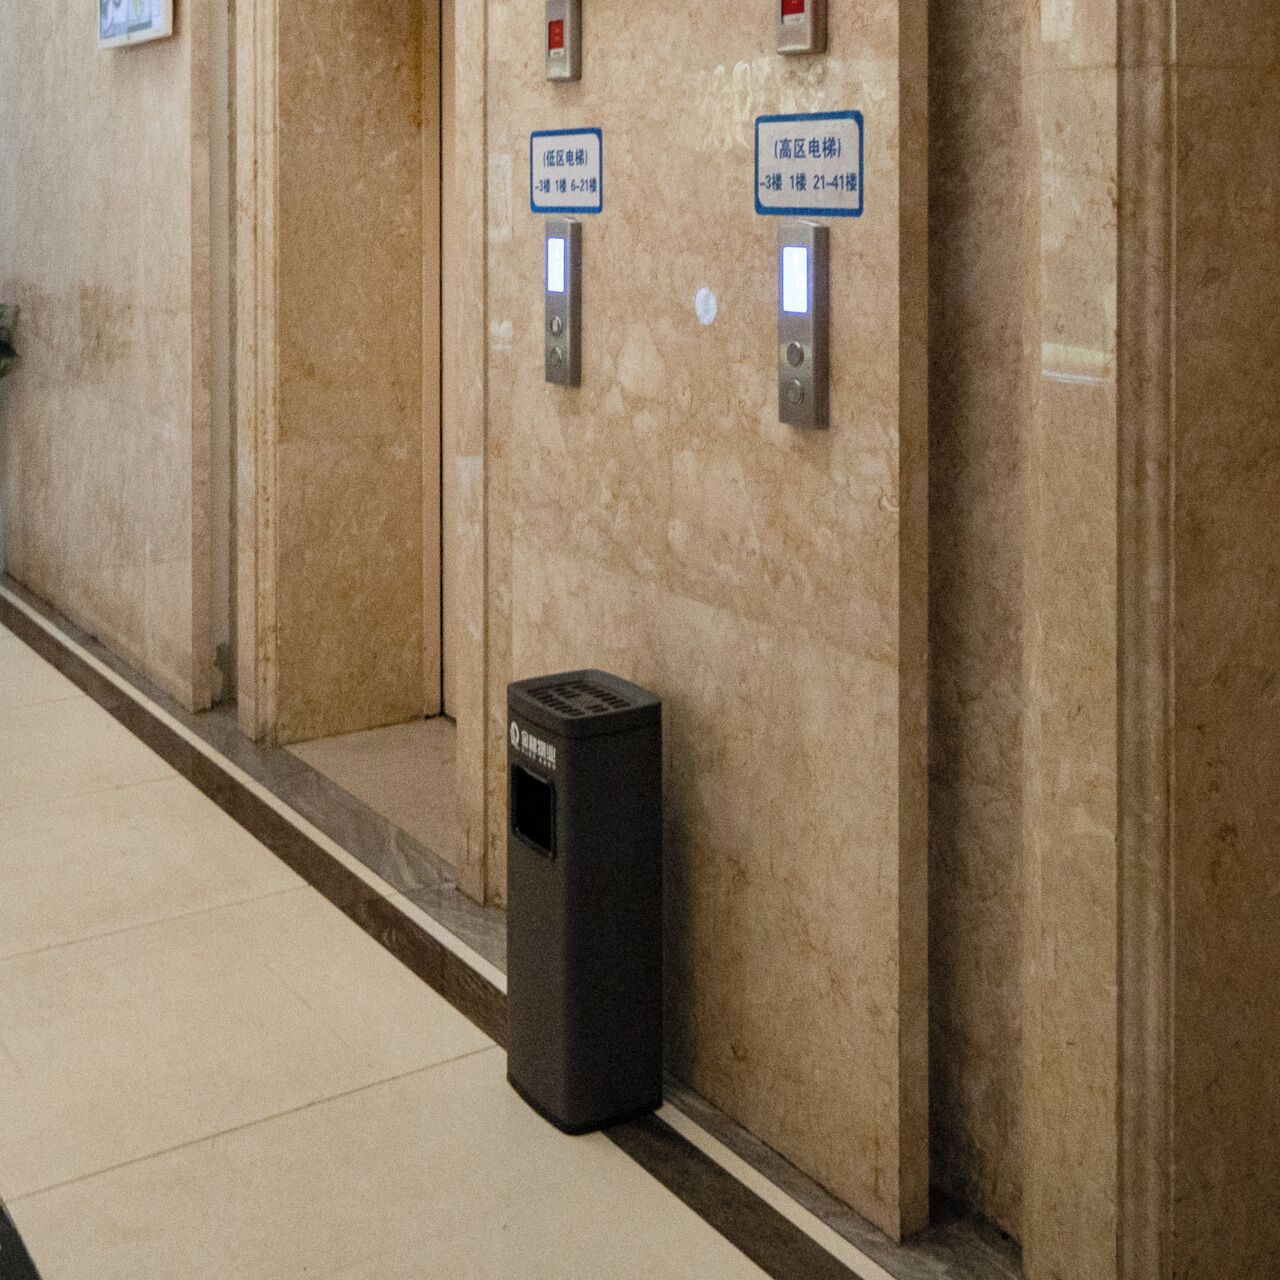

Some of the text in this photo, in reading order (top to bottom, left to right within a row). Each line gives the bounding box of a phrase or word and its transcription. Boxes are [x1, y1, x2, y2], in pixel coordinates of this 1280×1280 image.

[774, 136, 841, 159] (高区电梯)
[543, 149, 588, 168] (低区电梯)
[555, 178, 567, 194] 1楼
[570, 177, 597, 194] 6-21楼
[760, 171, 858, 192] -3楼 1楼 21-41楼
